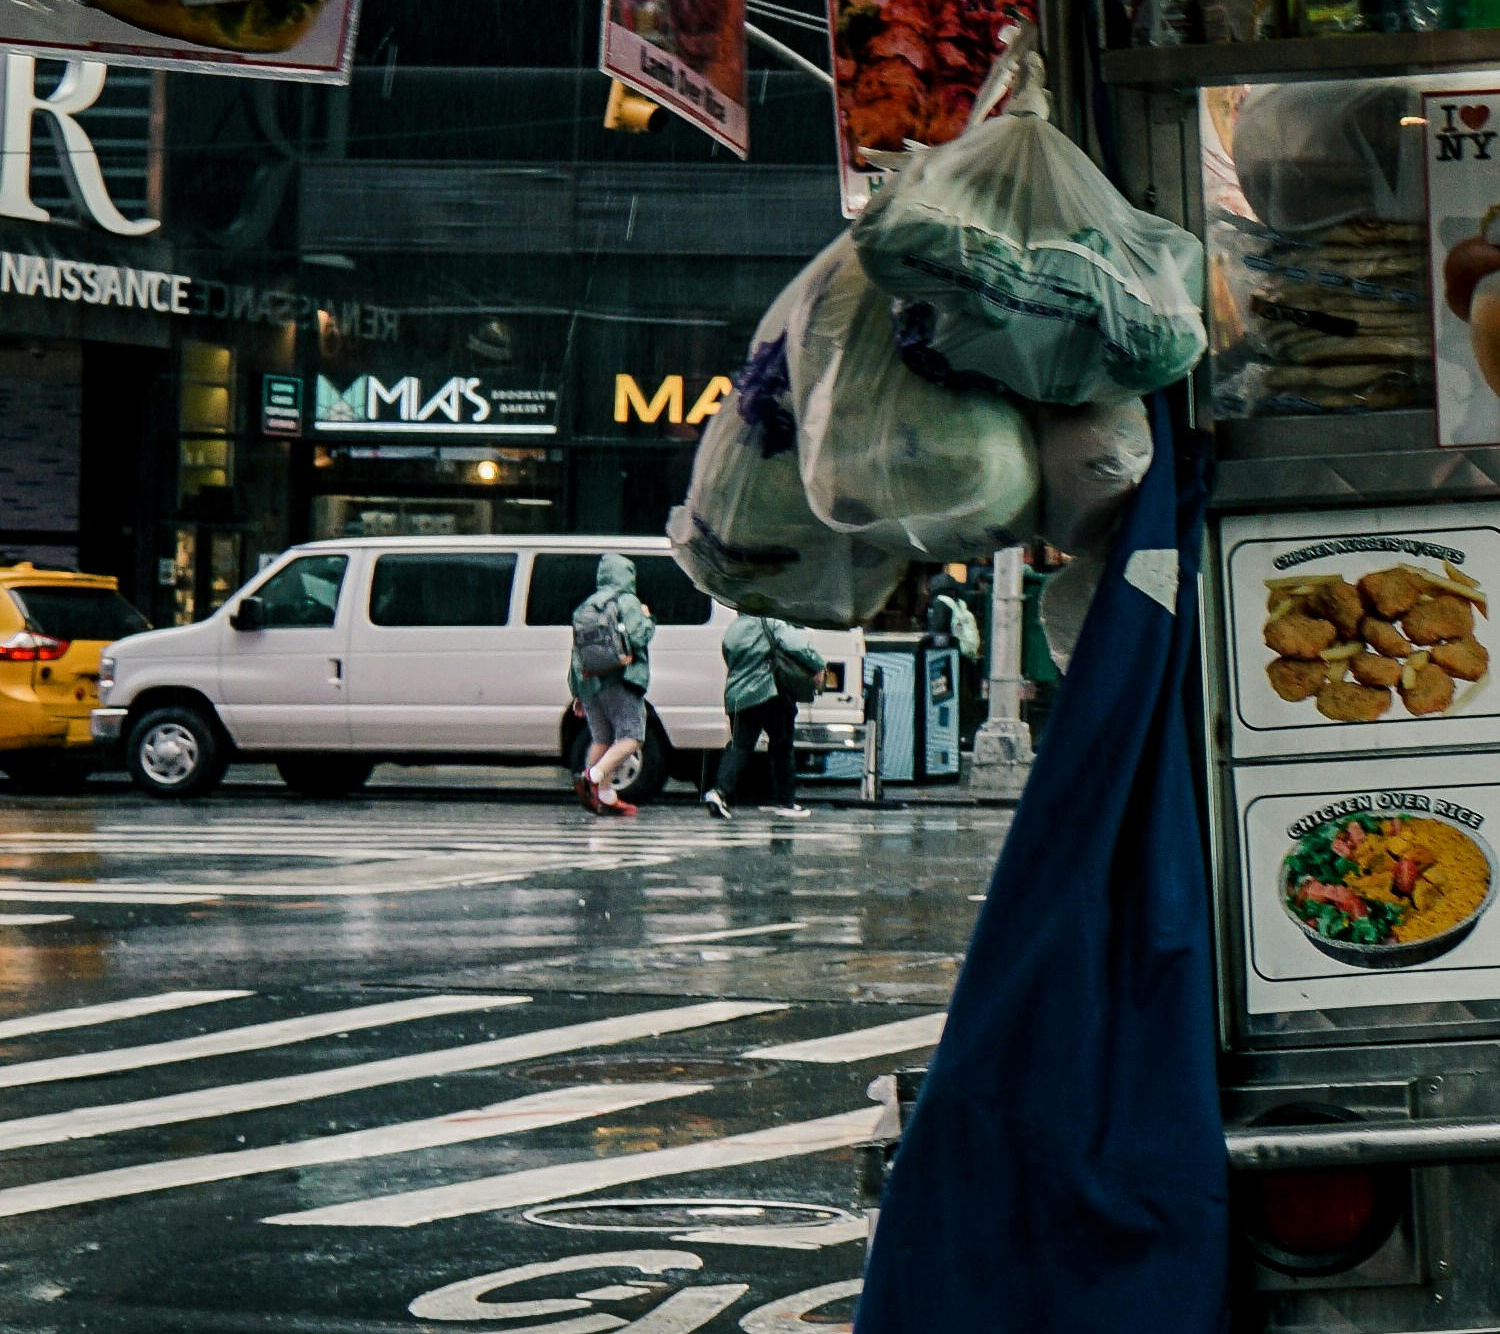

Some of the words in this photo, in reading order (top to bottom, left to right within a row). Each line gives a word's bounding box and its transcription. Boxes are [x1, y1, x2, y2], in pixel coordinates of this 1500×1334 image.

[1441, 104, 1457, 132] I
[1436, 131, 1497, 161] NY
[367, 376, 490, 422] MIA'S
[1288, 794, 1374, 840] CHICKEN
[1377, 792, 1431, 813] OVER
[1434, 797, 1484, 830] RICE
